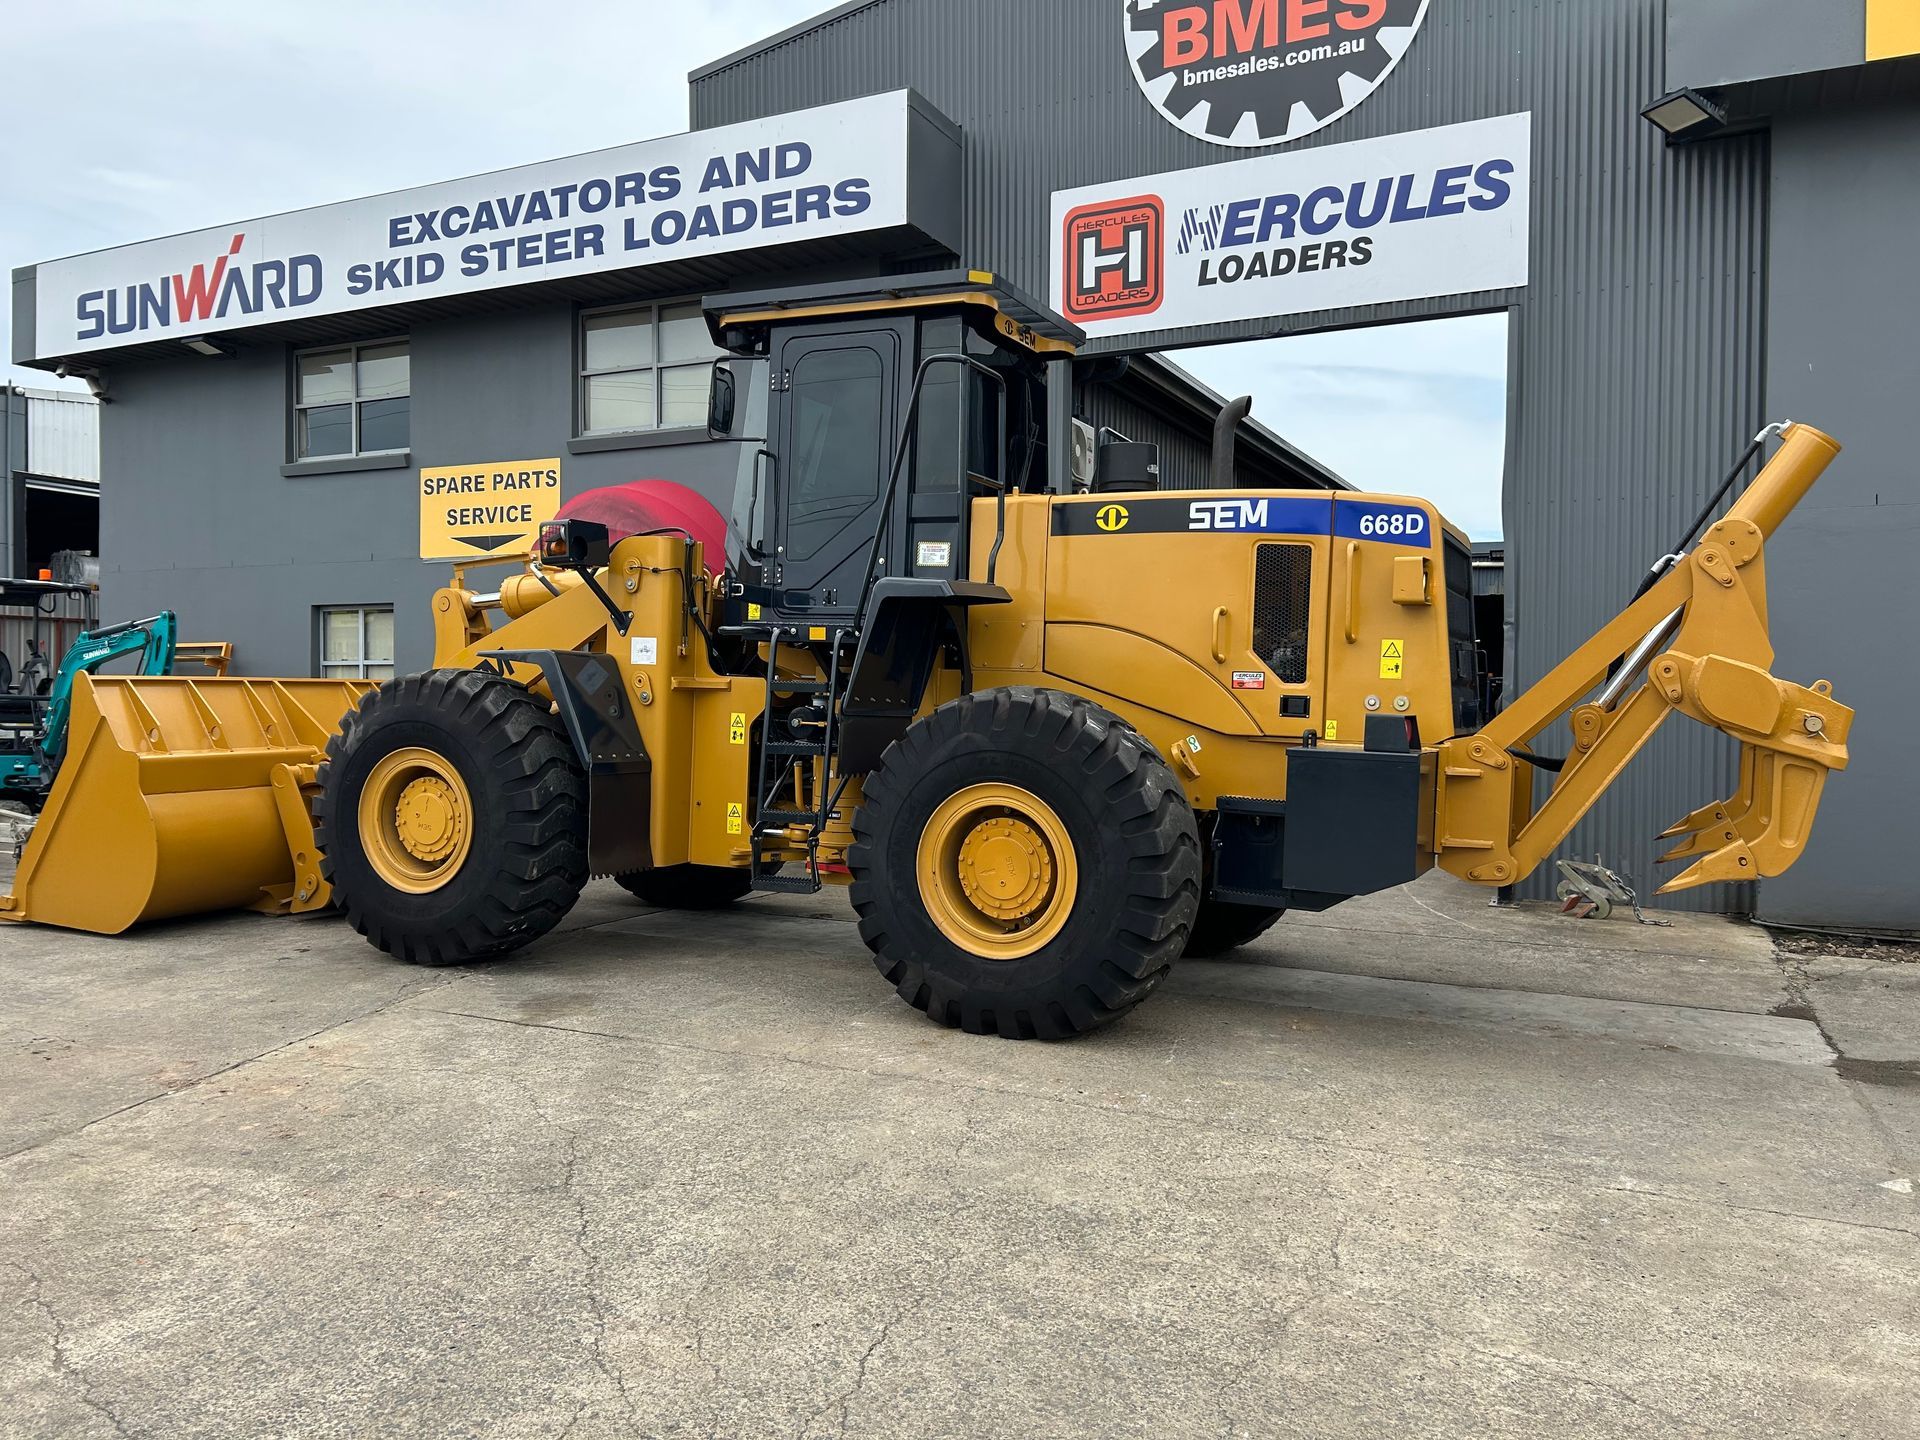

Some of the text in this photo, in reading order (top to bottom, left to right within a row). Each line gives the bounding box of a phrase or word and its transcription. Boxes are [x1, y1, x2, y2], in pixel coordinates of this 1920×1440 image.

[1184, 38, 1364, 87] bmesales.com.au
[389, 142, 811, 248] EXCAVATORS AND
[1175, 159, 1514, 254] HERCULES
[347, 178, 871, 295] SKID STEER LOADERS
[1077, 213, 1150, 231] HERCULES
[1198, 236, 1373, 286] LOADERS
[77, 233, 322, 340] SUNWARD
[1077, 288, 1150, 306] LOADERS
[424, 470, 557, 495] SPARE PARTS
[447, 505, 532, 526] SERVICE
[1188, 499, 1268, 529] SEM
[1359, 513, 1424, 535] 668D
